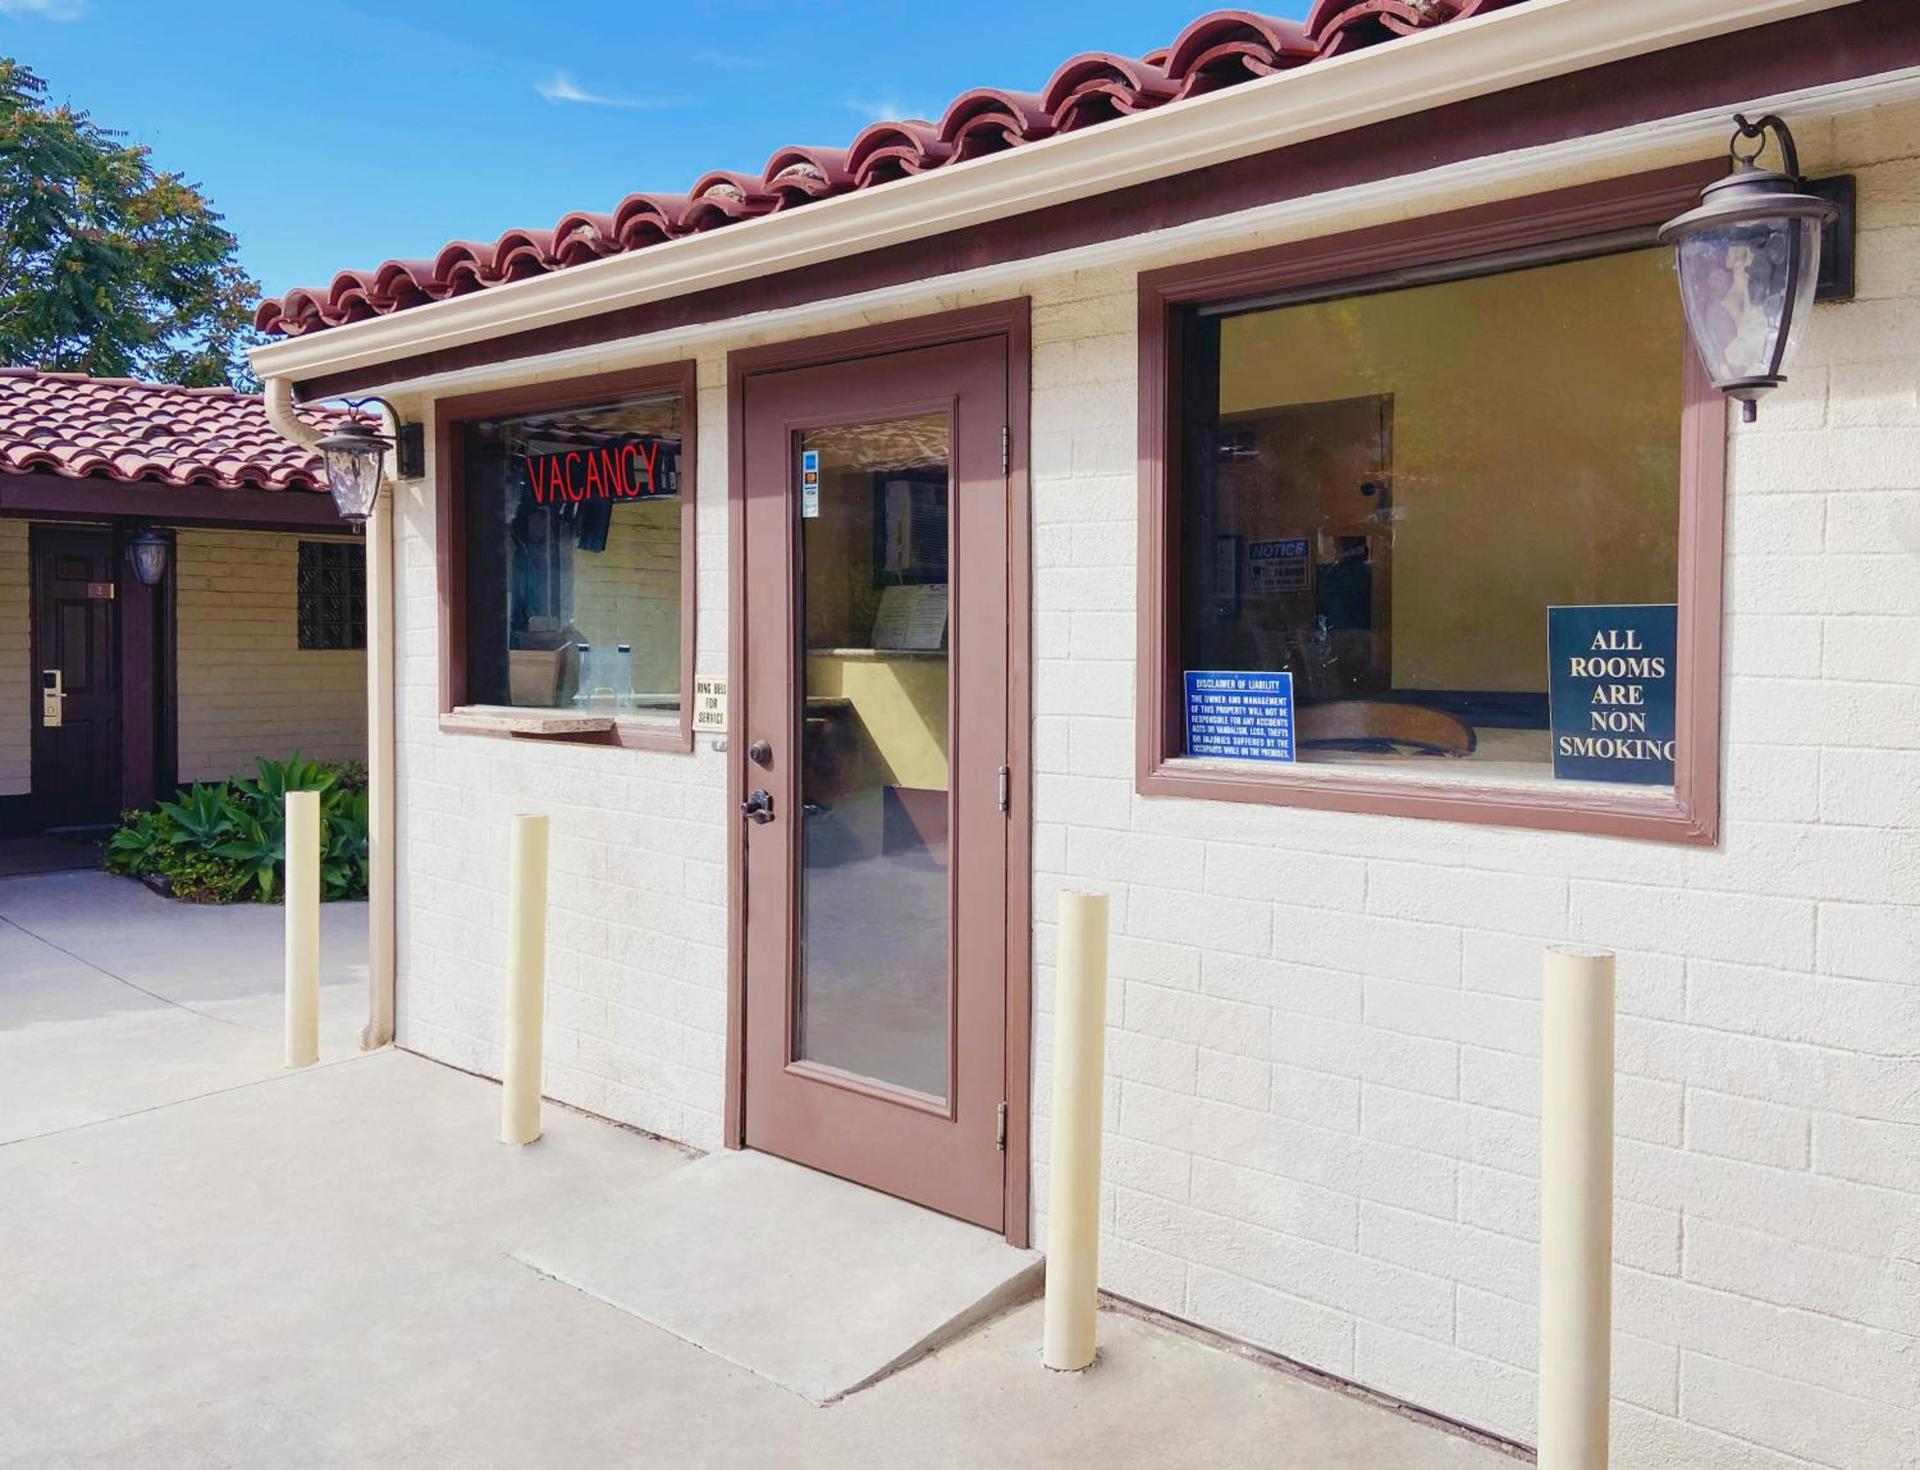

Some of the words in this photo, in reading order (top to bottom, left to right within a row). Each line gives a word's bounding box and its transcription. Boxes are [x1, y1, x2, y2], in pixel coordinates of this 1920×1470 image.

[527, 443, 657, 503] VACANCY
[1252, 542, 1305, 557] NOTICE
[1590, 630, 1643, 650] ALL
[1570, 657, 1665, 678] ROOMS
[714, 683, 727, 695] BELL
[1196, 679, 1236, 689] DISCLAIMER
[1237, 680, 1246, 689] OF
[1249, 680, 1280, 690] LIABILITY
[1191, 695, 1202, 703] THE
[1204, 695, 1226, 704] OWNER
[1228, 696, 1240, 704] AND
[1243, 696, 1287, 706] MANAGEMENT
[1591, 684, 1644, 705] ARE
[706, 698, 717, 709] FOR
[1191, 705, 1198, 713] OF
[1201, 705, 1214, 713] THIS
[1216, 706, 1246, 715] PROPERTY
[1248, 707, 1263, 716] WILL
[1265, 708, 1277, 716] NOT
[1280, 708, 1288, 716] BE
[698, 712, 723, 724] SERVICE
[1191, 715, 1228, 724] RESPONSIBLE
[1230, 716, 1240, 725] FOR
[1243, 717, 1254, 725] ANY
[1590, 711, 1646, 732] NON
[1267, 728, 1289, 737] THEFTS
[1203, 735, 1231, 744] INJURIES
[1232, 737, 1264, 746] SUFFERED
[1266, 739, 1275, 747] BY
[1277, 739, 1289, 748] THE
[1224, 746, 1239, 755] WHILE
[1250, 748, 1259, 756] THE
